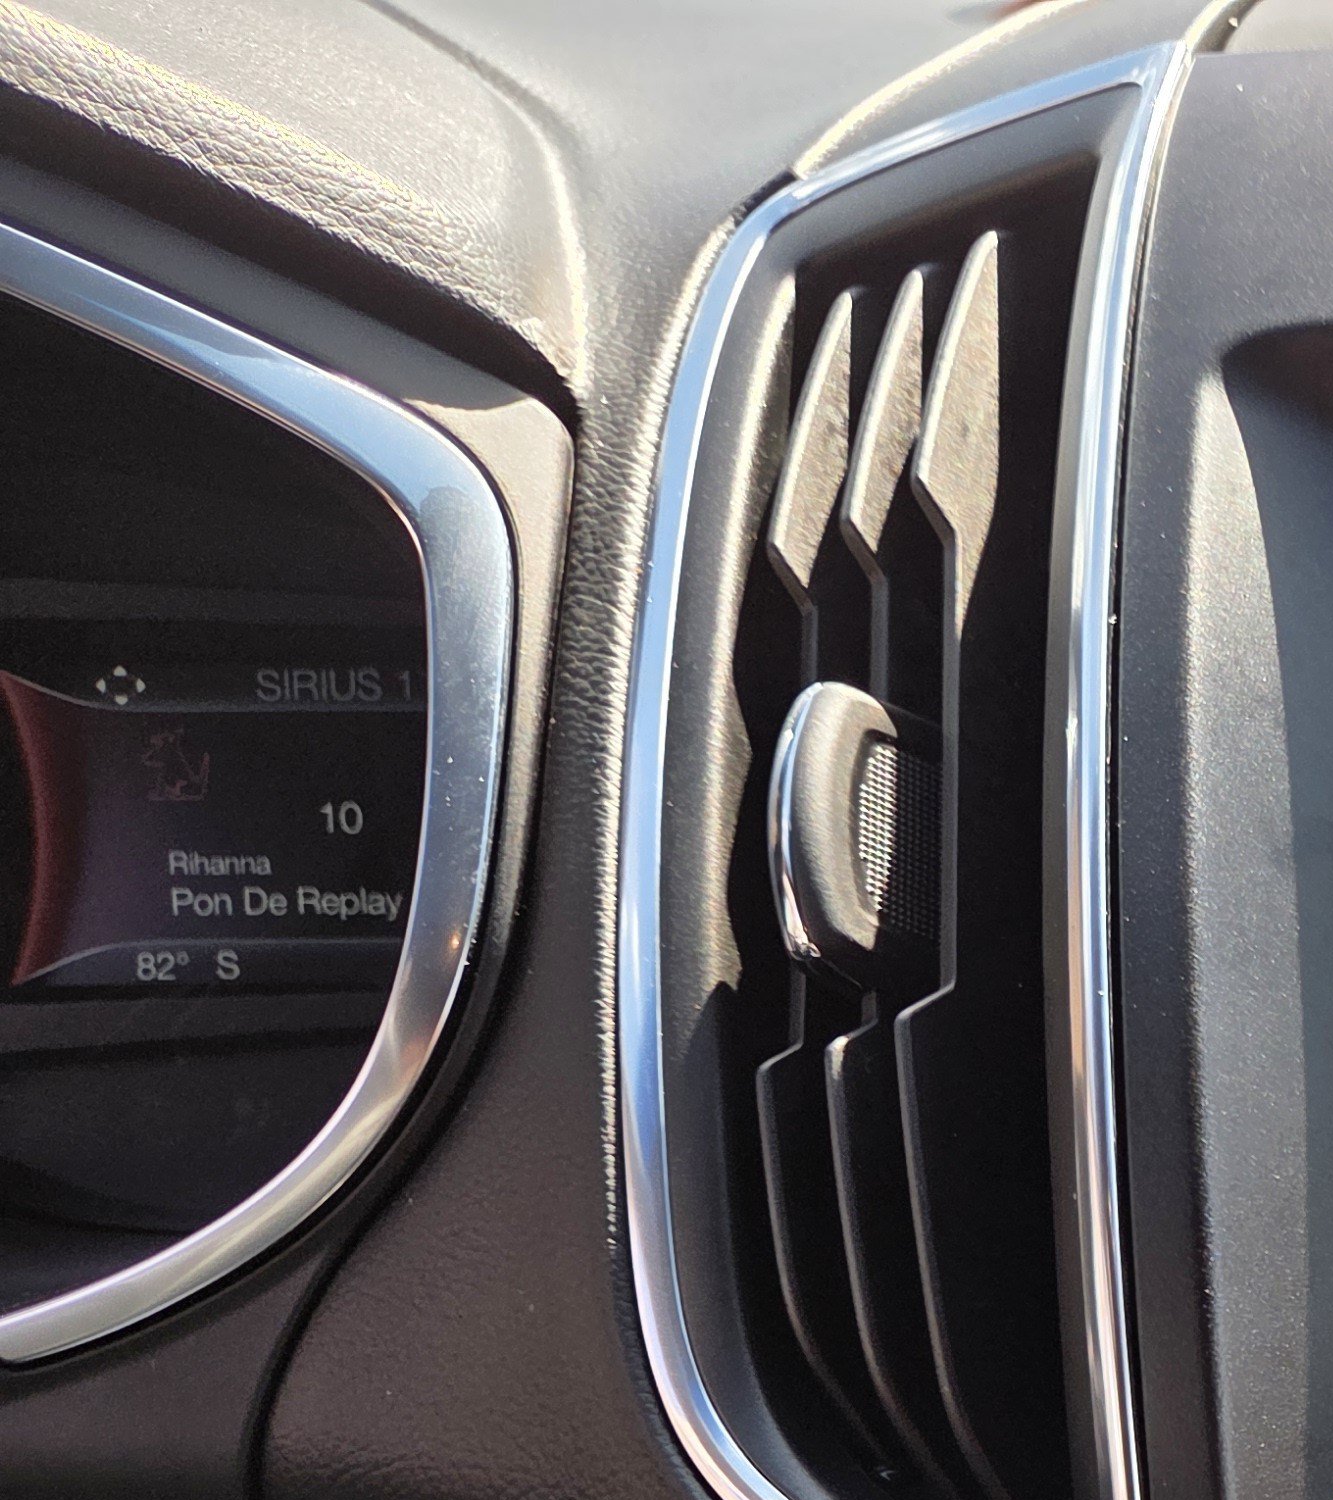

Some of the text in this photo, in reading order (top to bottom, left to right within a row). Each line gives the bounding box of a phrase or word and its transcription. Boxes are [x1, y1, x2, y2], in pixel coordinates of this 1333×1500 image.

[254, 666, 384, 702] SIRIUS
[319, 802, 364, 835] 10
[168, 850, 272, 876] Rihanna
[171, 886, 403, 922] Pon De Replay
[216, 951, 241, 981] S
